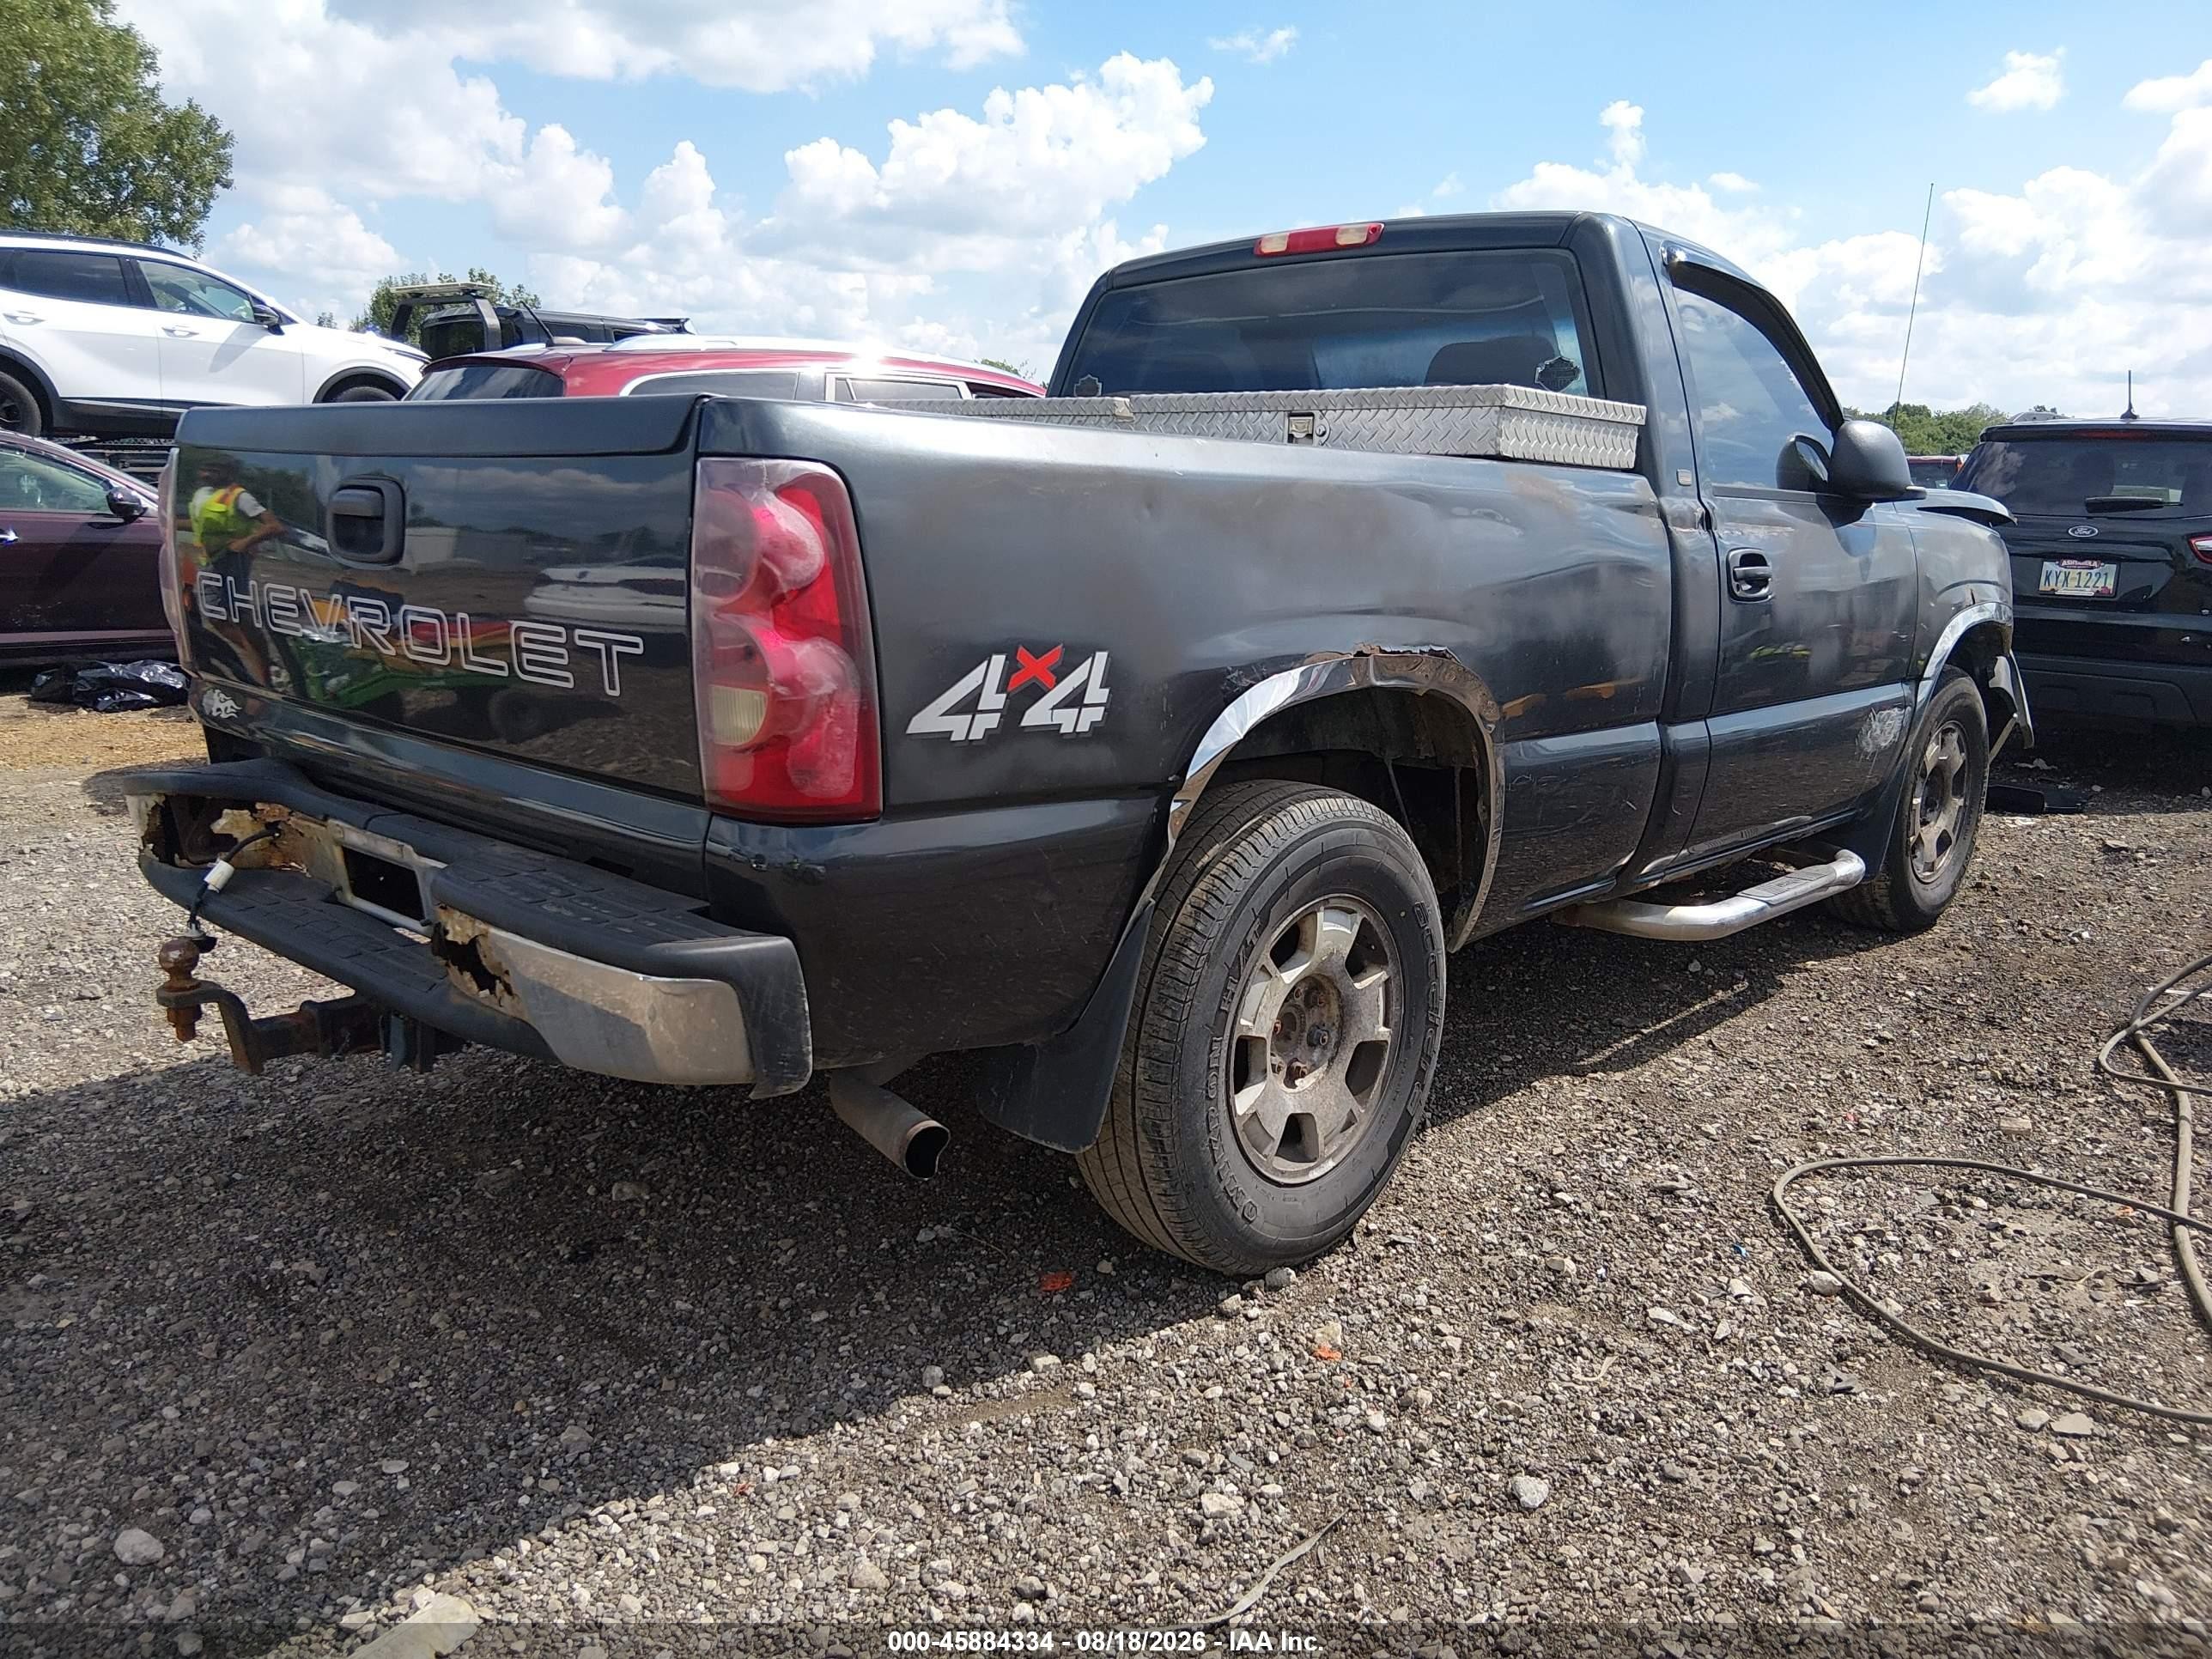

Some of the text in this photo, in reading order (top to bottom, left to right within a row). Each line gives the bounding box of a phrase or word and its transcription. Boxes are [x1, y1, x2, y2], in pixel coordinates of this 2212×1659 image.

[2044, 570, 2108, 589] KYX 1221
[196, 571, 644, 696] CHEVROLET
